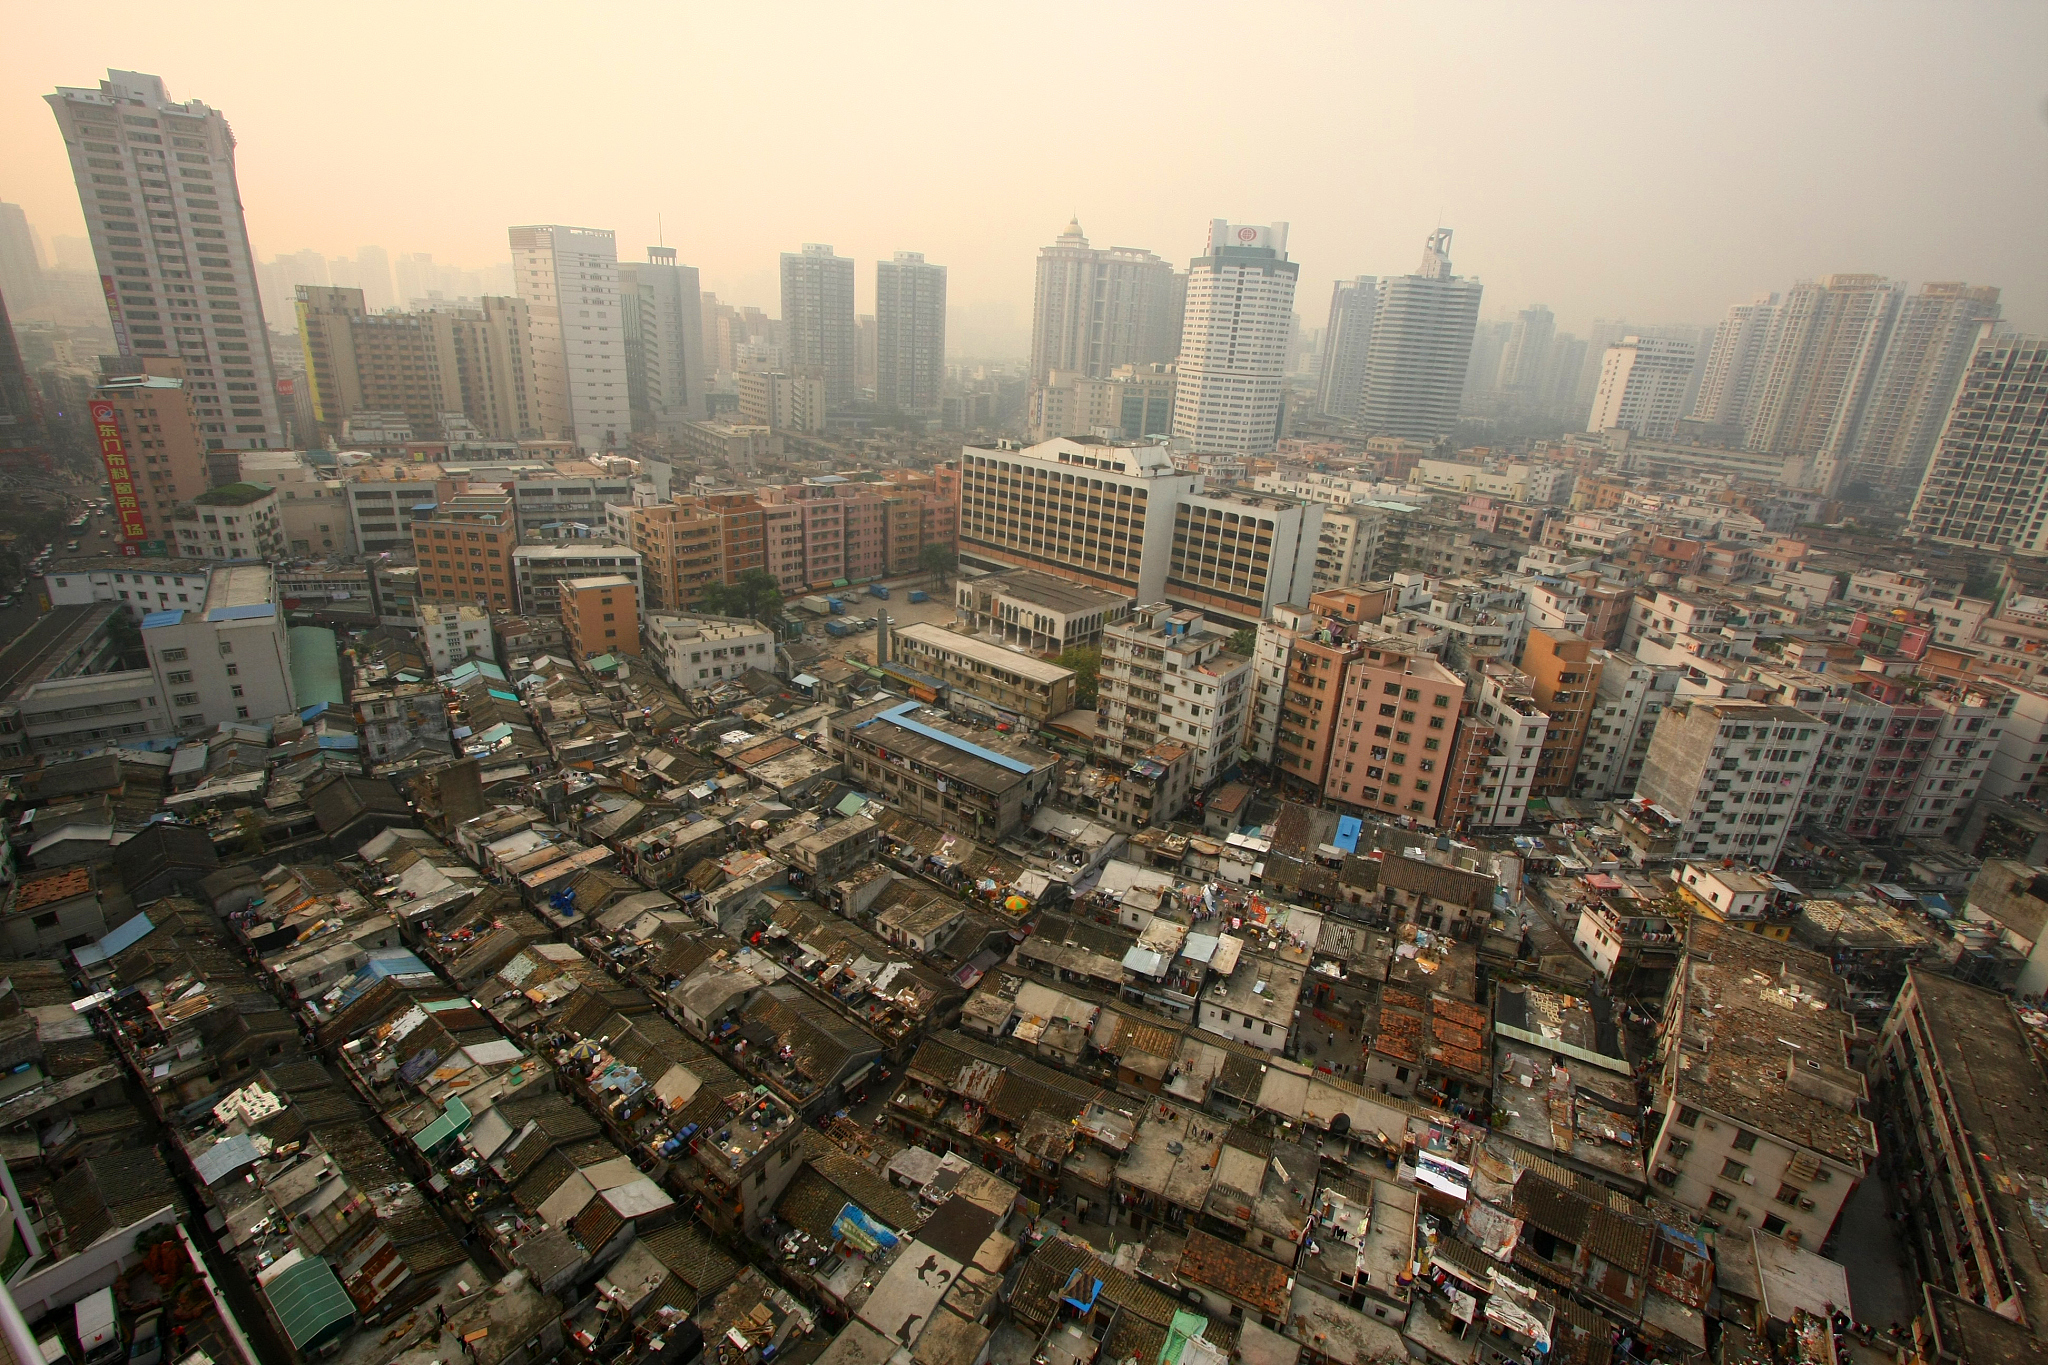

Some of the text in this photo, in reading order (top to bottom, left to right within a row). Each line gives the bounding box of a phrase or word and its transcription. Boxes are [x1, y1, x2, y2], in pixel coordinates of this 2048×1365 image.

[98, 424, 144, 536] 东门布料窗帘广场
